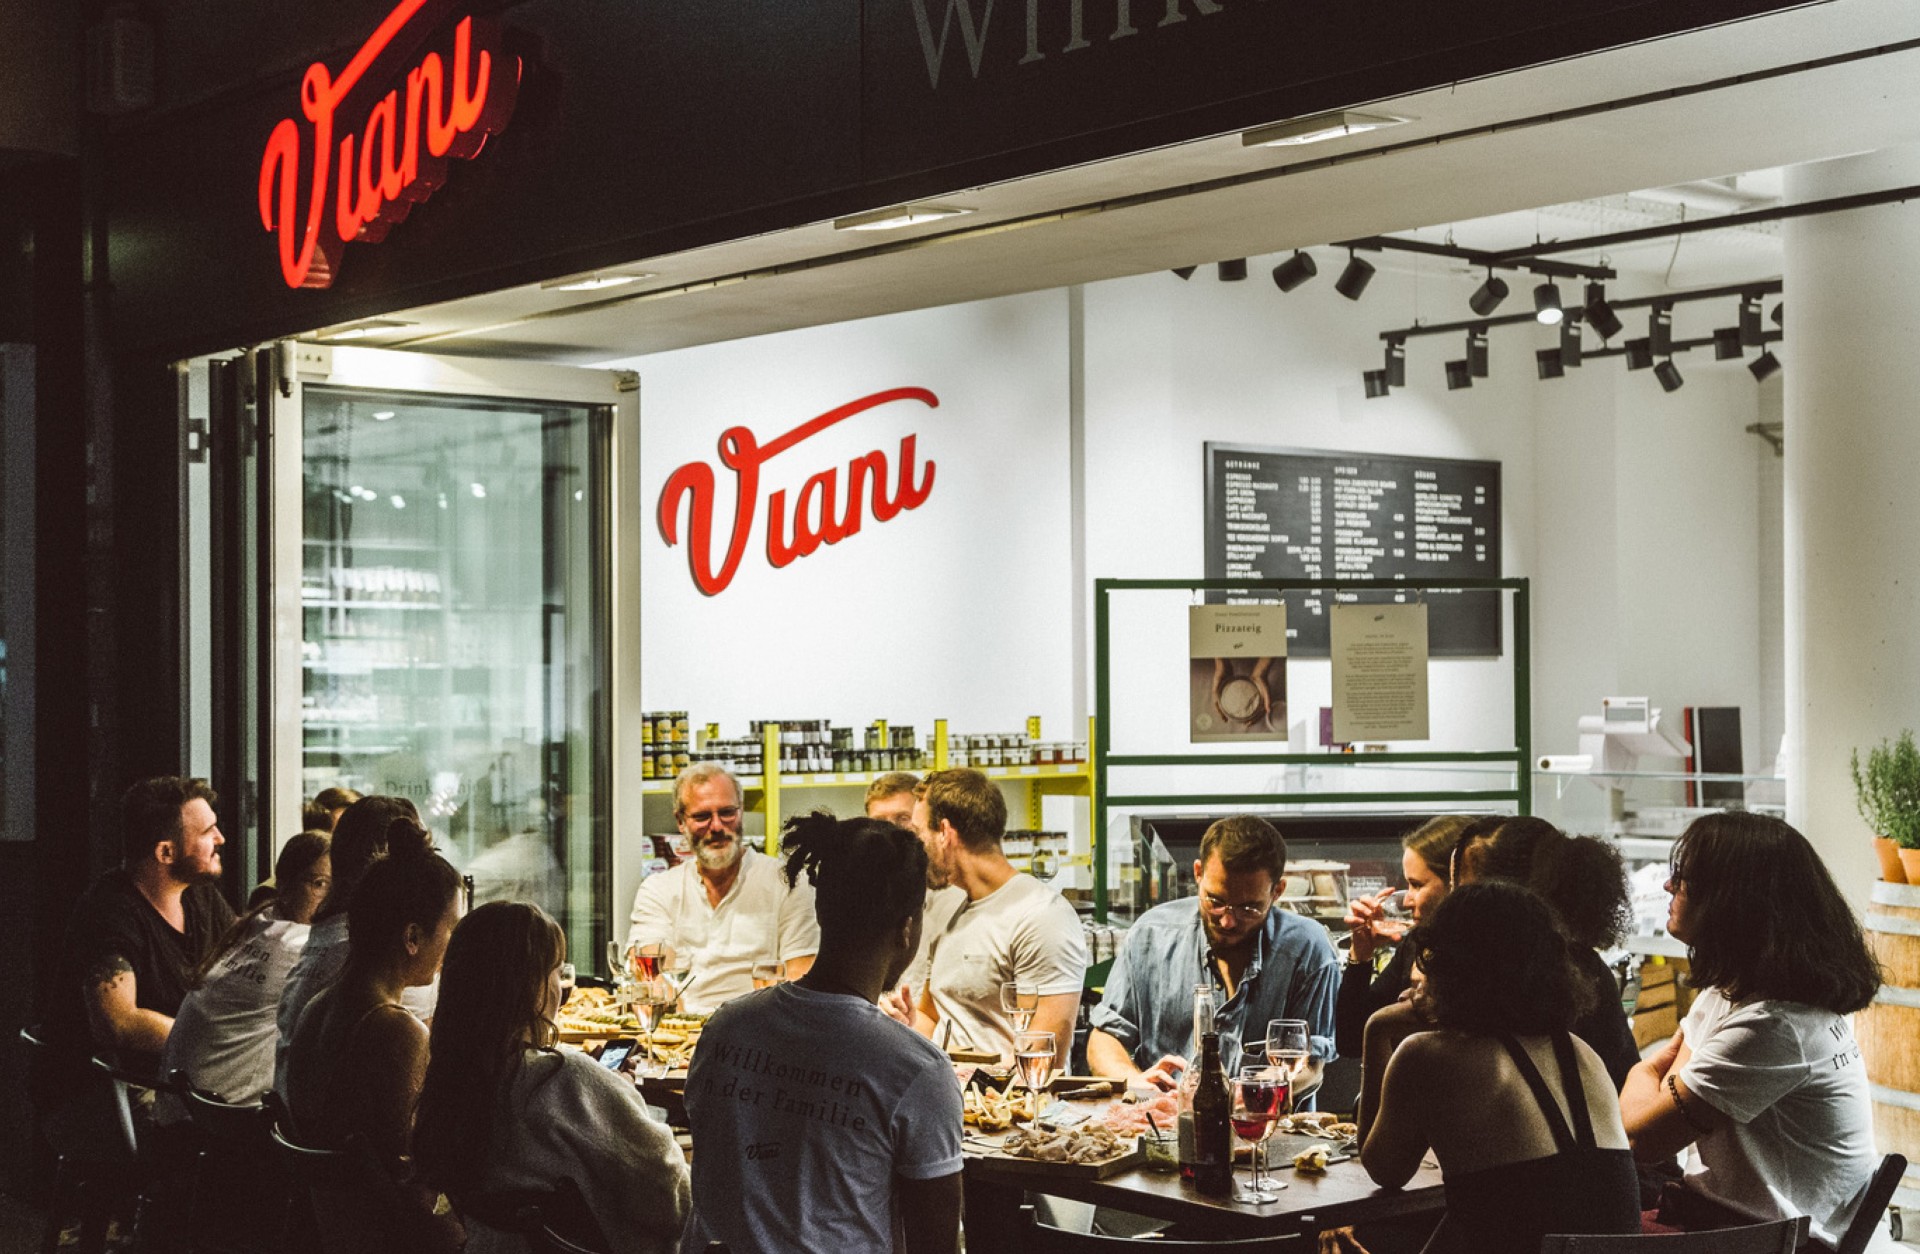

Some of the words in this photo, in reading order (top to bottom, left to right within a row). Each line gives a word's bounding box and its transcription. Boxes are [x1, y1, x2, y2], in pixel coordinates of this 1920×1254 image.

[258, 0, 493, 289] Viani
[657, 386, 940, 597] Viani
[1215, 623, 1261, 634] Pizzateig
[713, 1042, 861, 1098] Willkommen
[723, 1077, 765, 1104] der
[773, 1089, 867, 1132] Familie
